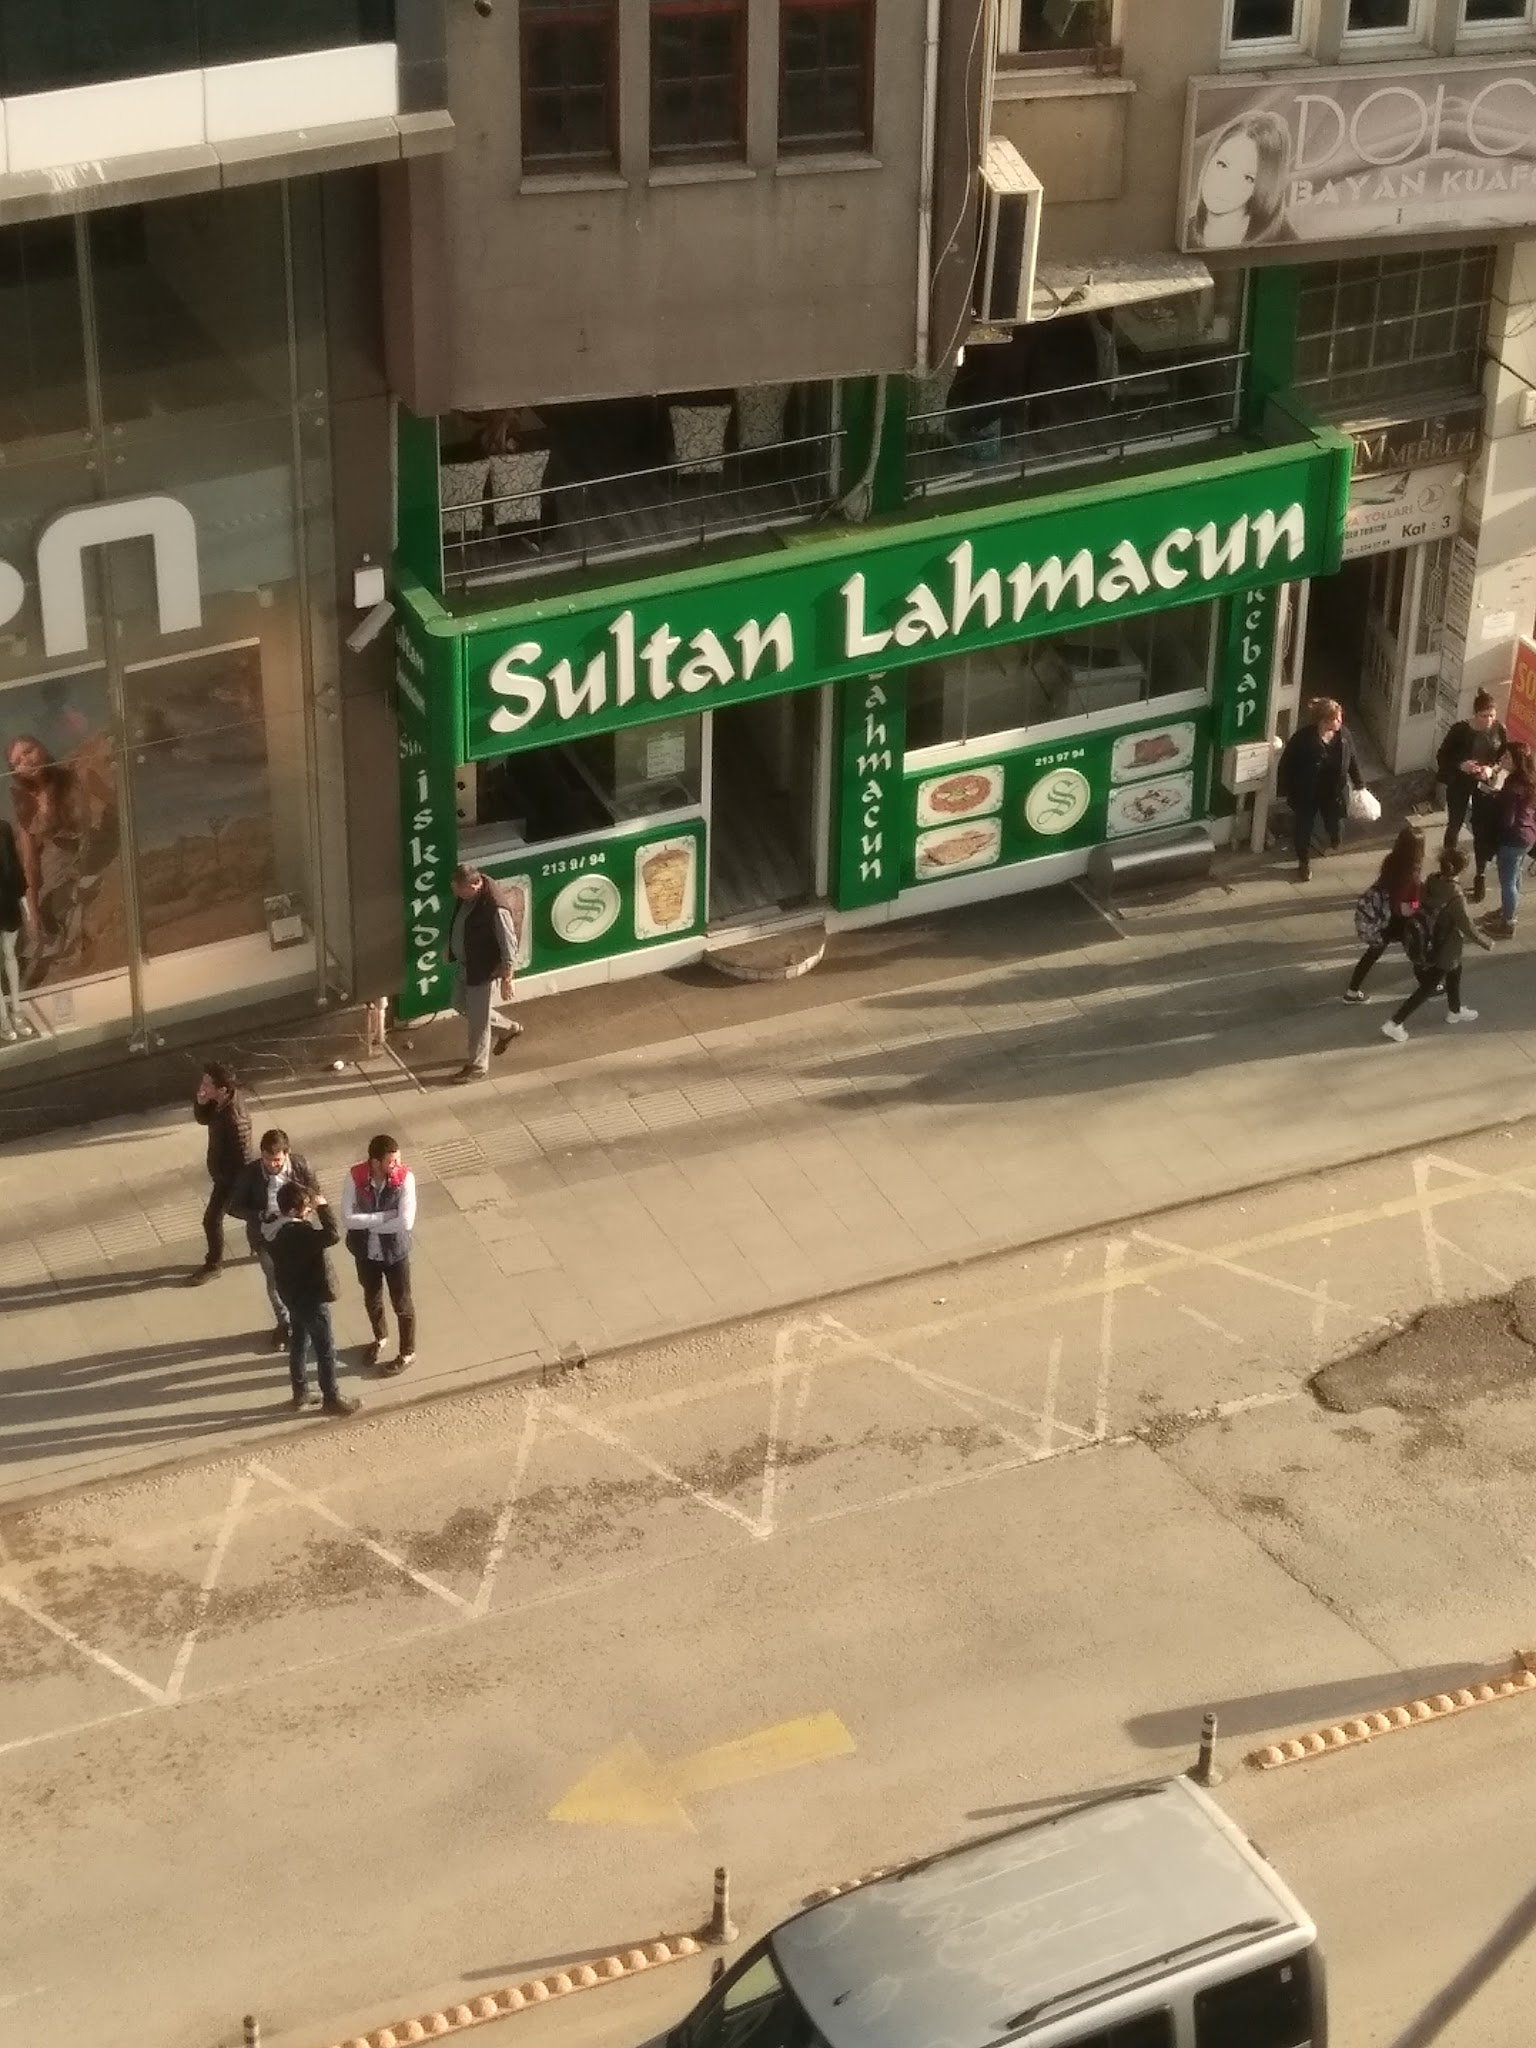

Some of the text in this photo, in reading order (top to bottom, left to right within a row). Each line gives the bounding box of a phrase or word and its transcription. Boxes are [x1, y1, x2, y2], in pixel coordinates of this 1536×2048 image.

[1289, 164, 1536, 207] BAYAN KUAF
[1401, 521, 1427, 539] Kat
[1441, 514, 1451, 530] 3
[488, 610, 795, 734] Sultan
[840, 502, 1307, 659] Lahmacun
[1034, 755, 1055, 767] 213
[1071, 747, 1085, 759] 94
[541, 861, 567, 877] 213
[589, 852, 606, 867] 94
[410, 768, 441, 997] iskender
